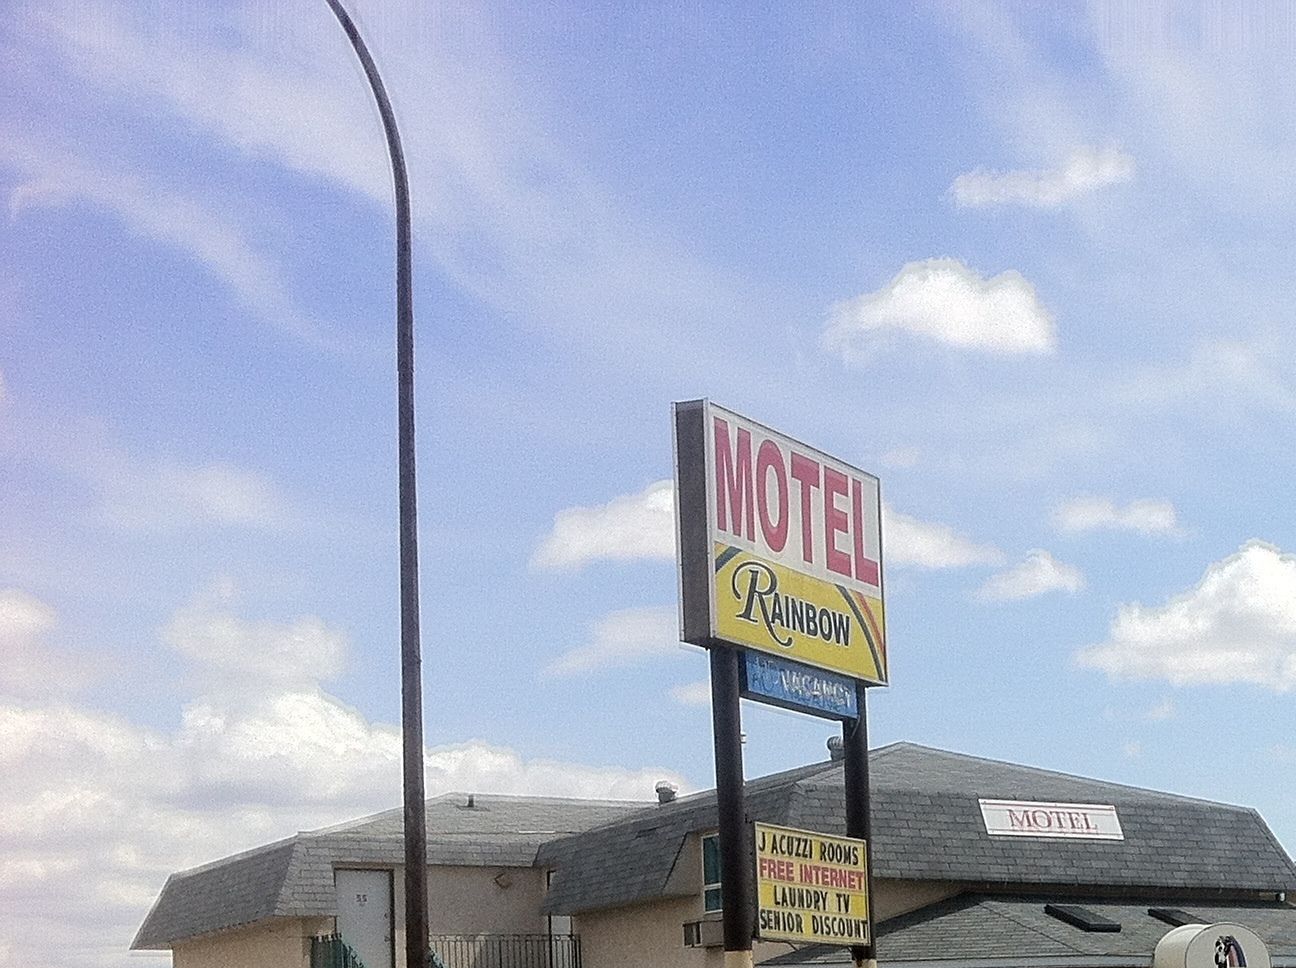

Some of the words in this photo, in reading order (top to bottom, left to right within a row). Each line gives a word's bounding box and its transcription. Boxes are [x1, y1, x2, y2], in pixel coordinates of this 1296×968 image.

[713, 416, 880, 588] MOTEL
[731, 560, 851, 647] RAINBOW
[1007, 808, 1098, 830] MOTEL
[820, 842, 860, 866] ROOMS
[760, 858, 795, 882] FREE
[800, 864, 865, 890] INTERNET
[774, 885, 828, 911] LAUNDRY
[836, 893, 850, 914] TV
[760, 909, 804, 934] SENIOR
[811, 915, 869, 939] DISCOUNT
